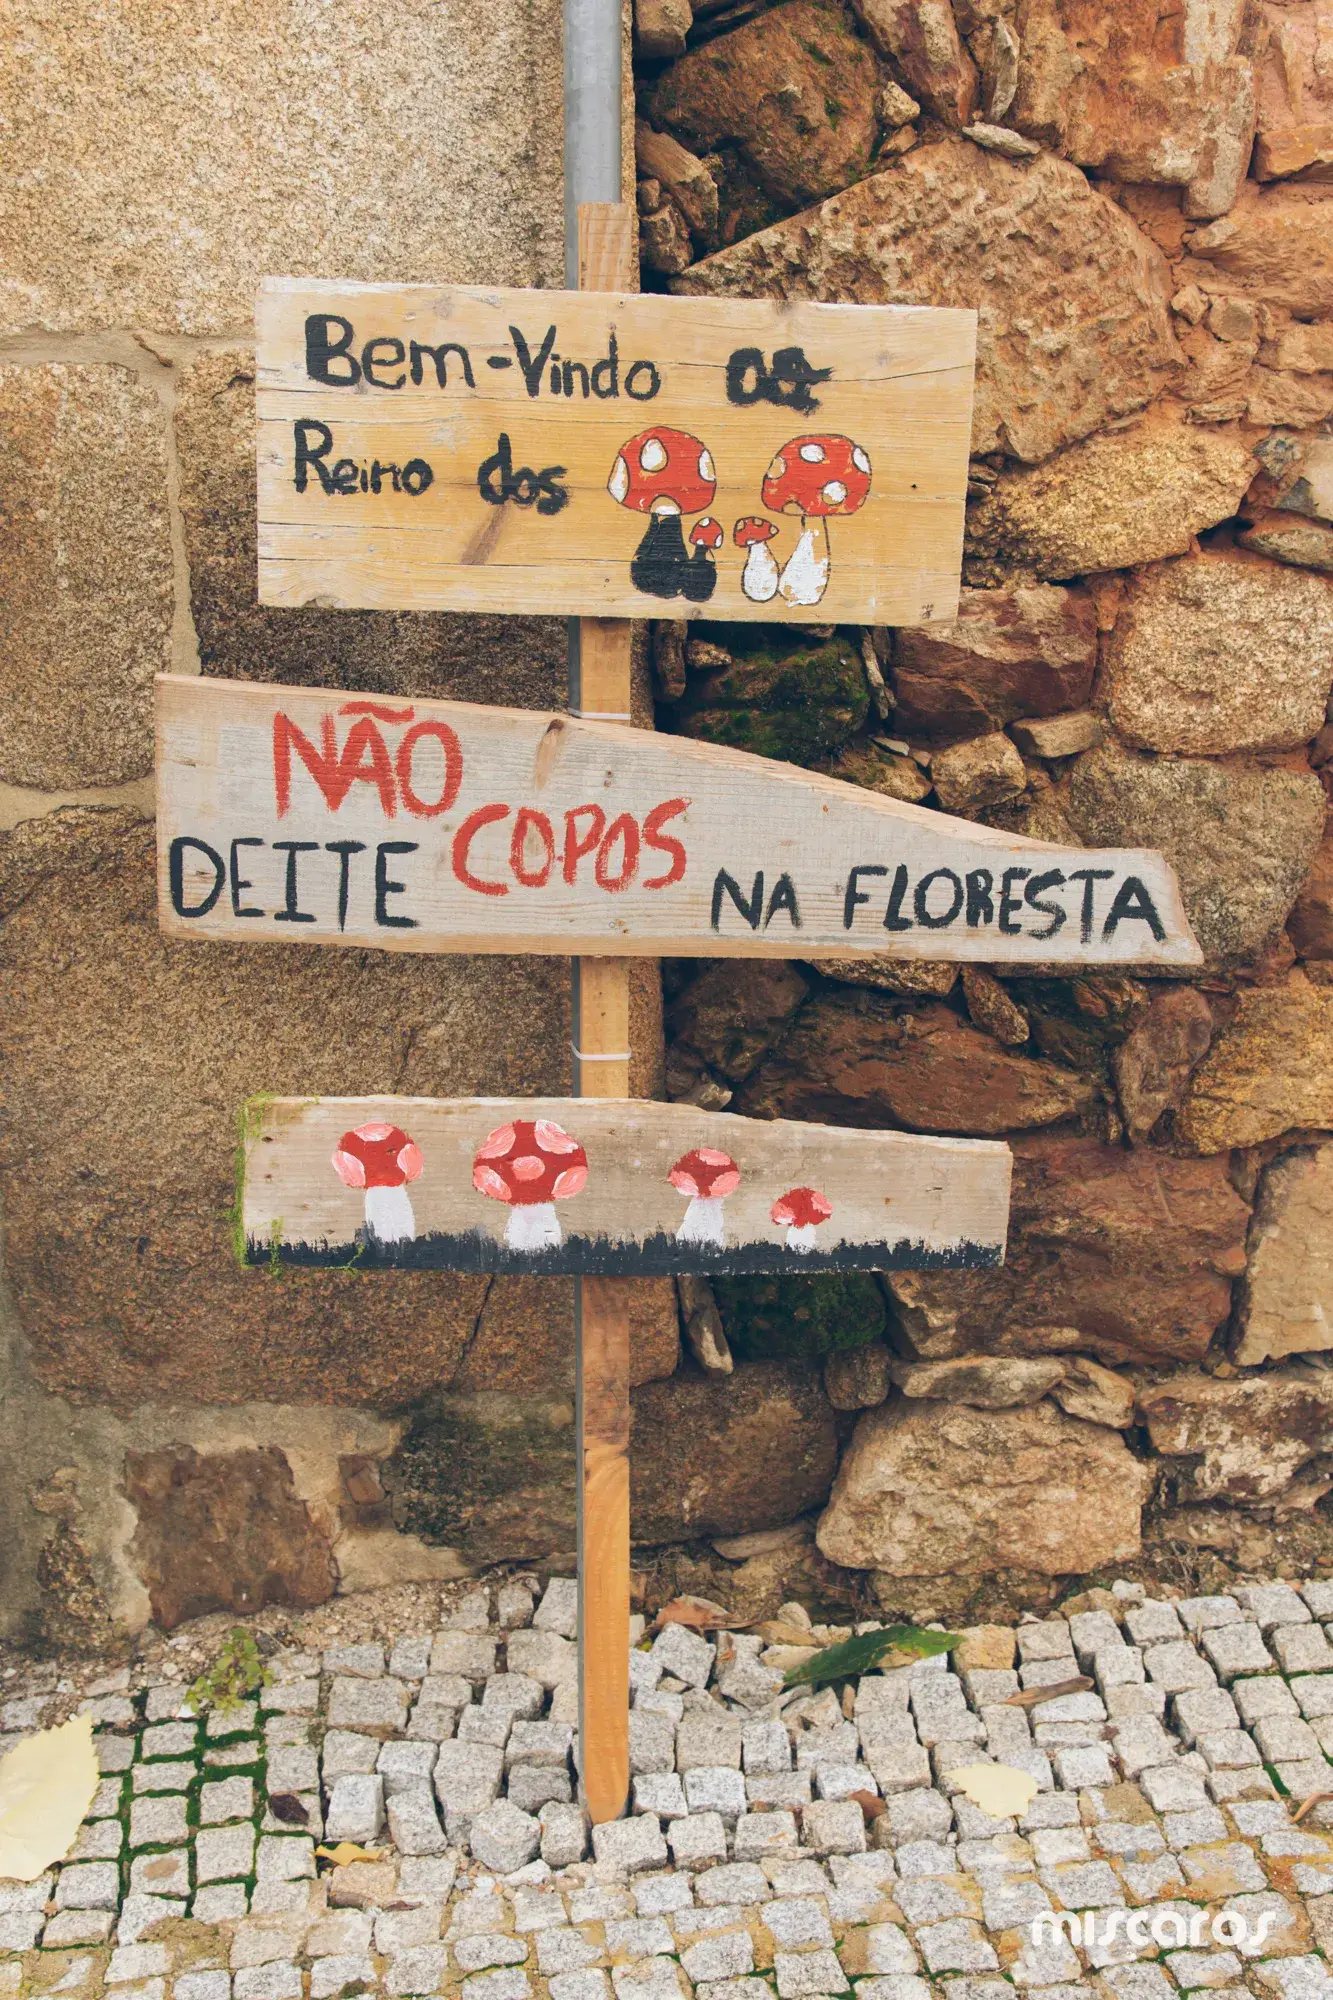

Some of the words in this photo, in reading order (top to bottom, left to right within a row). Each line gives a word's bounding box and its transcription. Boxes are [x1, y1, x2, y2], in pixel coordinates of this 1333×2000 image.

[305, 313, 661, 401] Bem-Vindo
[294, 418, 434, 496] Reino
[477, 432, 569, 516] dos
[273, 701, 463, 819] NÃO
[169, 836, 420, 932] DEITE
[452, 797, 691, 896] COPOS
[711, 866, 803, 933] NA
[843, 863, 1167, 945] FLORESTA
